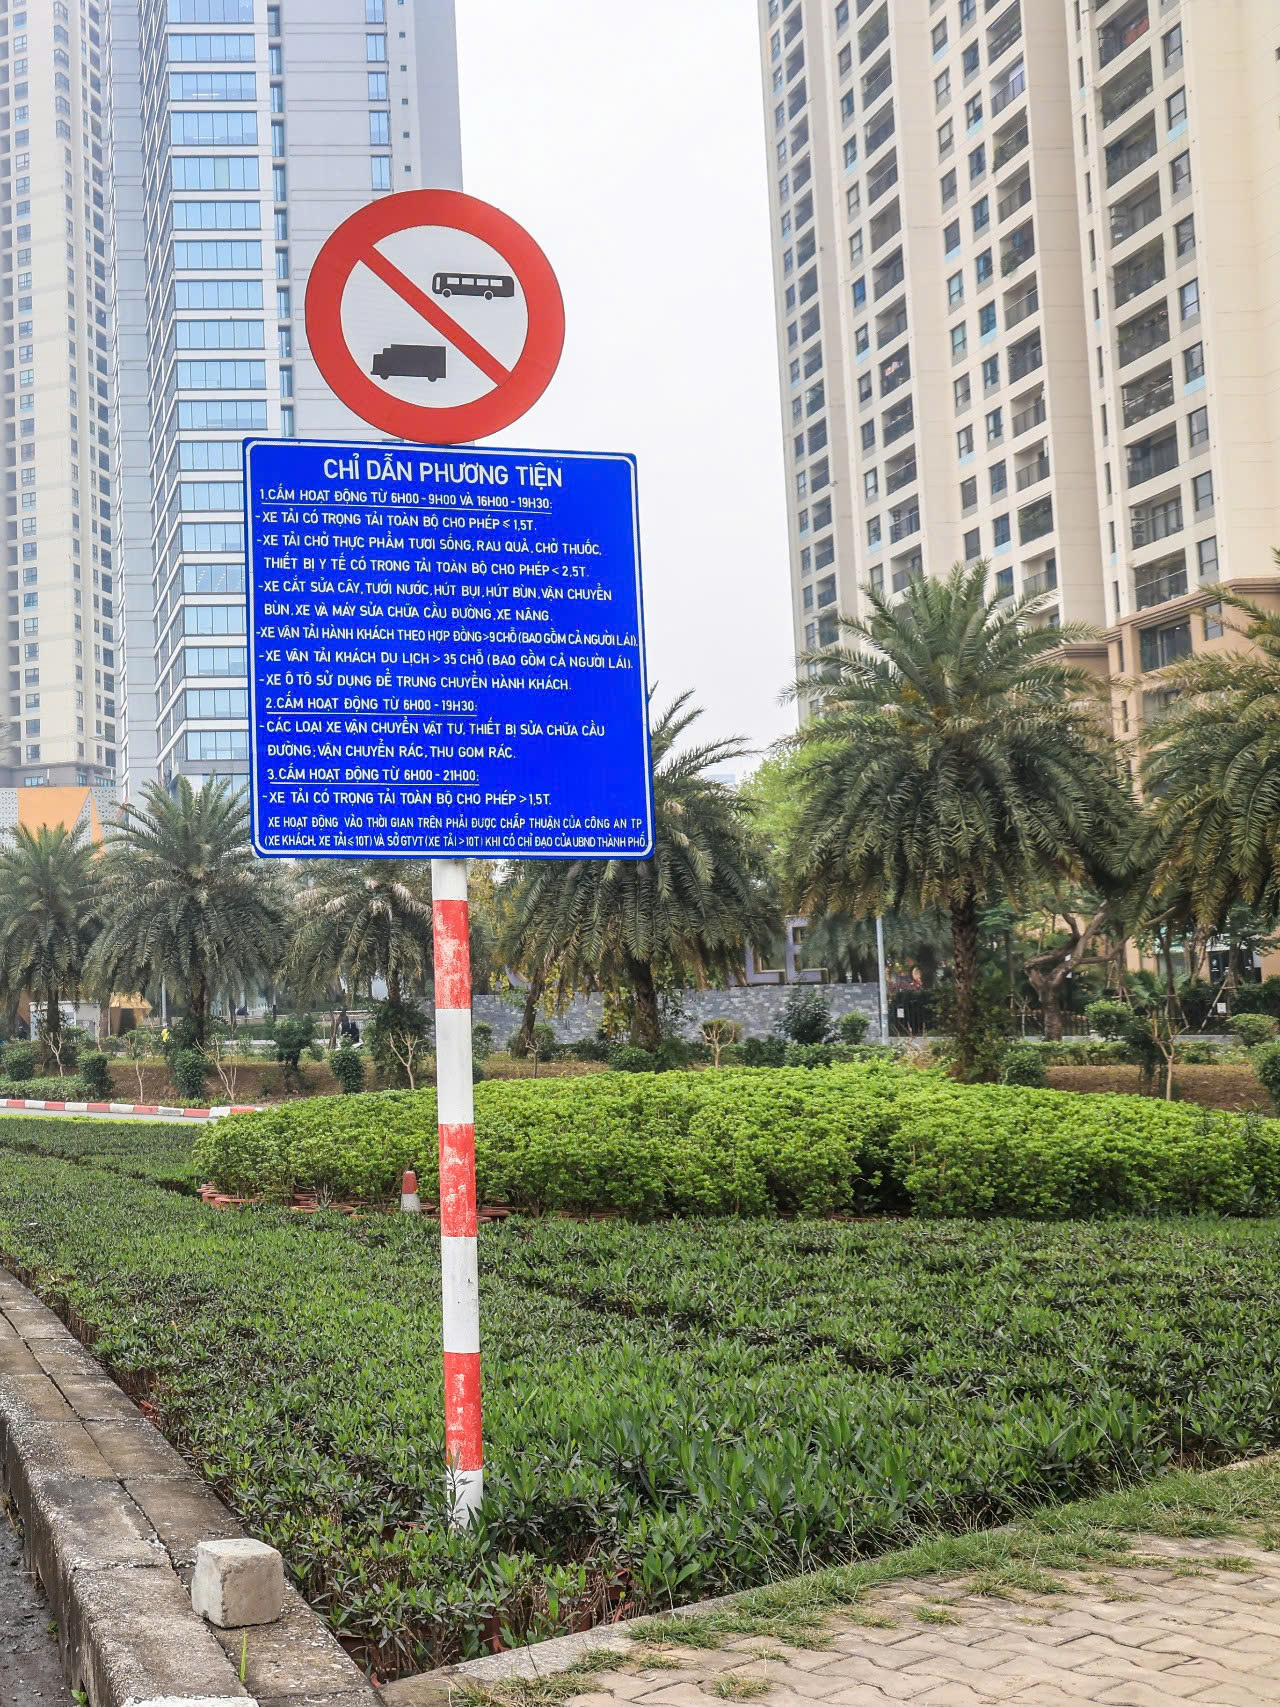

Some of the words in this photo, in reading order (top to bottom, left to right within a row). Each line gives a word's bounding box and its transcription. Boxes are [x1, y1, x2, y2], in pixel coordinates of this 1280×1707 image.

[324, 453, 359, 480] CHỈ
[366, 453, 412, 481] DẪN
[419, 462, 508, 485] PHƯƠNG
[515, 461, 562, 490] TIỆN
[300, 489, 330, 503] HOẠT
[334, 488, 367, 504] ĐỘNG
[370, 488, 387, 503] TỪ
[391, 492, 419, 504] 6H00
[428, 494, 456, 505] 9H00
[460, 492, 474, 506] VÀ
[477, 495, 509, 507] 16H00
[281, 508, 299, 523] TẢI
[303, 509, 318, 524] CÓ
[321, 513, 361, 527] TRỌNG
[365, 511, 383, 525] TẢI
[387, 512, 418, 527] TOÀN
[423, 514, 439, 530] BỘ
[442, 517, 465, 528] CHO
[469, 514, 500, 529] PHÉP
[282, 531, 300, 546] TẢI
[304, 531, 329, 547] CHỞ
[332, 536, 365, 551] THỰC
[369, 530, 404, 549] PHẨM
[408, 538, 435, 550] TƯƠI
[477, 540, 501, 552] RAU
[535, 538, 558, 553] CHỞ
[264, 551, 298, 569] THIẾT
[303, 558, 315, 572] BỊ
[330, 552, 346, 570] TẾ
[350, 556, 366, 571] CÓ
[370, 560, 410, 572] TRONG
[414, 557, 431, 572] TẢI
[436, 559, 467, 574] TOÀN
[472, 560, 487, 576] BỘ
[491, 563, 515, 575] CHO
[519, 561, 550, 576] PHÉP
[283, 575, 306, 592] CẮT
[310, 577, 335, 593] SỬA
[365, 579, 392, 594] TƯỚI
[434, 582, 456, 596] HÚT
[486, 583, 509, 597] HÚT
[540, 585, 563, 601] VẬN
[567, 582, 612, 601] CHUYỂN
[295, 604, 310, 616] XE
[314, 602, 328, 616] VÀ
[332, 602, 356, 616] MÁY
[360, 601, 384, 617] SỬA
[424, 601, 447, 619] CẦU
[496, 609, 511, 620] XE
[277, 625, 300, 640] VẬN
[302, 623, 319, 639] TẢI
[322, 624, 354, 640] HÀNH
[357, 625, 394, 640] KHÁCH
[397, 629, 426, 641] THEO
[428, 630, 450, 644] HỢP
[453, 626, 482, 642] ĐỒNG
[496, 627, 517, 643] CHỖ
[543, 627, 566, 644] GỒM
[568, 629, 583, 645] CẢ
[584, 630, 615, 646] NGƯỜI
[313, 647, 331, 662] TẢI
[335, 648, 376, 663] KHÁCH
[381, 652, 398, 663] DU
[402, 652, 429, 666] LỊCH
[444, 653, 457, 665] 35
[460, 649, 484, 665] CHỖ
[520, 649, 546, 666] GỒM
[550, 652, 566, 667] CẢ
[569, 653, 605, 668] NGƯỜI
[296, 671, 312, 685] TÔ
[316, 670, 333, 686] SỬ
[337, 675, 372, 688] DỤNG
[376, 668, 392, 687] ĐỂ
[396, 676, 436, 688] TRUNG
[441, 670, 487, 688] CHUYỂN
[492, 674, 525, 689] HÀNH
[308, 697, 339, 711] HOẠT
[344, 695, 378, 712] ĐỘNG
[383, 696, 399, 710] TỪ
[403, 699, 431, 711] 6H00
[296, 721, 322, 735] LOẠI
[326, 721, 342, 733] XE
[344, 718, 367, 735] VẬN
[371, 715, 419, 734] CHUYỂN
[423, 721, 443, 736] VẬT
[469, 717, 501, 735] THIẾT
[505, 724, 516, 737] BỊ
[520, 720, 543, 735] SỬA
[582, 720, 605, 736] CẦU
[317, 742, 342, 759] VẬN
[345, 738, 394, 757] CHUYỂN
[429, 746, 454, 758] THU
[458, 746, 484, 758] GOM
[309, 768, 340, 782] HOẠT
[345, 765, 379, 783] ĐỘNG
[382, 765, 400, 781] TỪ
[404, 769, 433, 781] 6H00
[290, 787, 309, 803] TẢI
[313, 788, 330, 803] CÓ
[333, 792, 374, 806] TRỌNG
[377, 788, 395, 804] TẢI
[400, 789, 432, 804] TOÀN
[436, 790, 453, 807] BỘ
[456, 793, 481, 805] CHO
[485, 789, 516, 805] PHÉP
[268, 816, 280, 828] XE
[283, 816, 308, 830] HOẠT
[312, 814, 339, 831] ĐỘNG
[344, 813, 363, 828] VÀO
[366, 814, 387, 828] THỜI
[390, 817, 414, 828] GIAN
[417, 815, 442, 828] TRÊN
[446, 814, 468, 828] PHẢI
[471, 818, 497, 830] ĐƯỢC
[500, 813, 525, 829] CHẤP
[529, 815, 560, 830] THUẬN
[563, 815, 582, 829] CỦA
[584, 816, 610, 829] CÔNG
[613, 818, 627, 828] AN
[631, 818, 642, 829] TP
[264, 835, 280, 846] (XE
[319, 835, 331, 846] XE
[333, 831, 346, 846] TẢI
[400, 836, 424, 846] GTVT
[425, 836, 440, 847] (XE
[443, 832, 457, 846] TẢI
[485, 836, 501, 846] KHI
[517, 832, 533, 847] CHỈ
[535, 836, 553, 848] ĐẠO
[554, 833, 572, 847] CỦA
[572, 836, 596, 847] UBND
[597, 834, 626, 847] THÀNH
